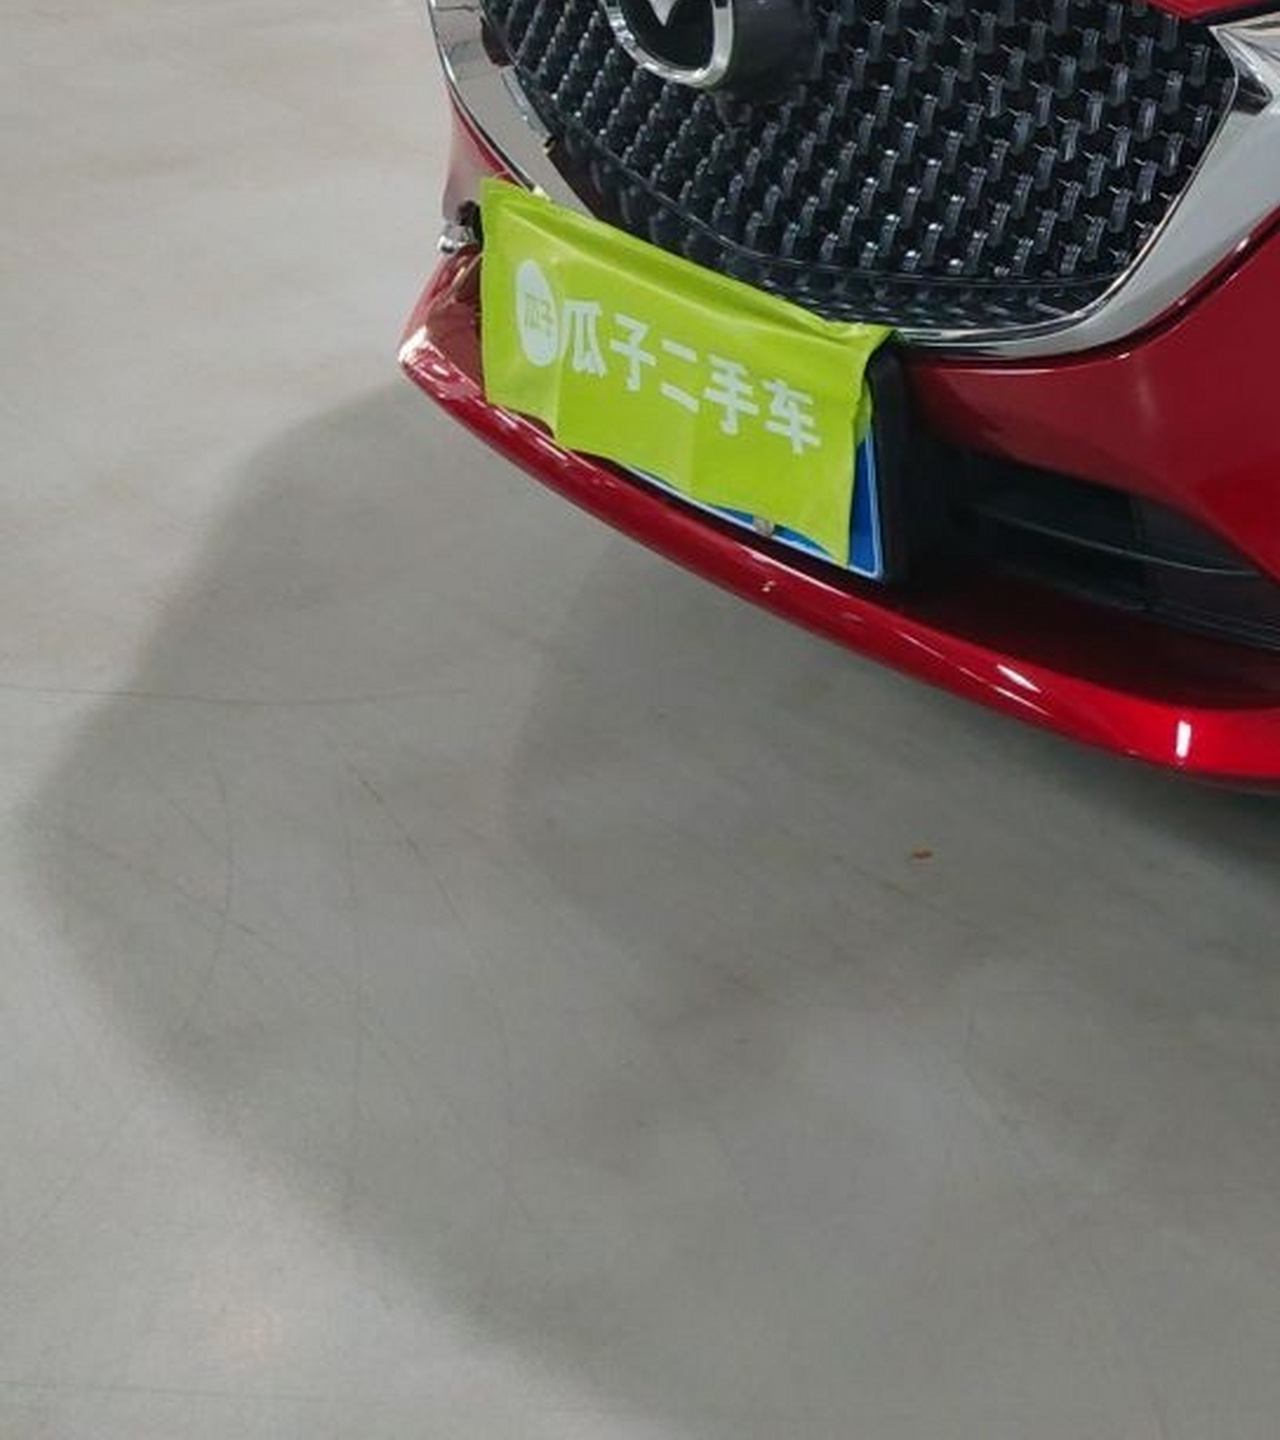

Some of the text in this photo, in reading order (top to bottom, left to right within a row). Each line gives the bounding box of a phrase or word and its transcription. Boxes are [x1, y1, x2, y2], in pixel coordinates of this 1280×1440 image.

[561, 299, 821, 454] 瓜子二手车
